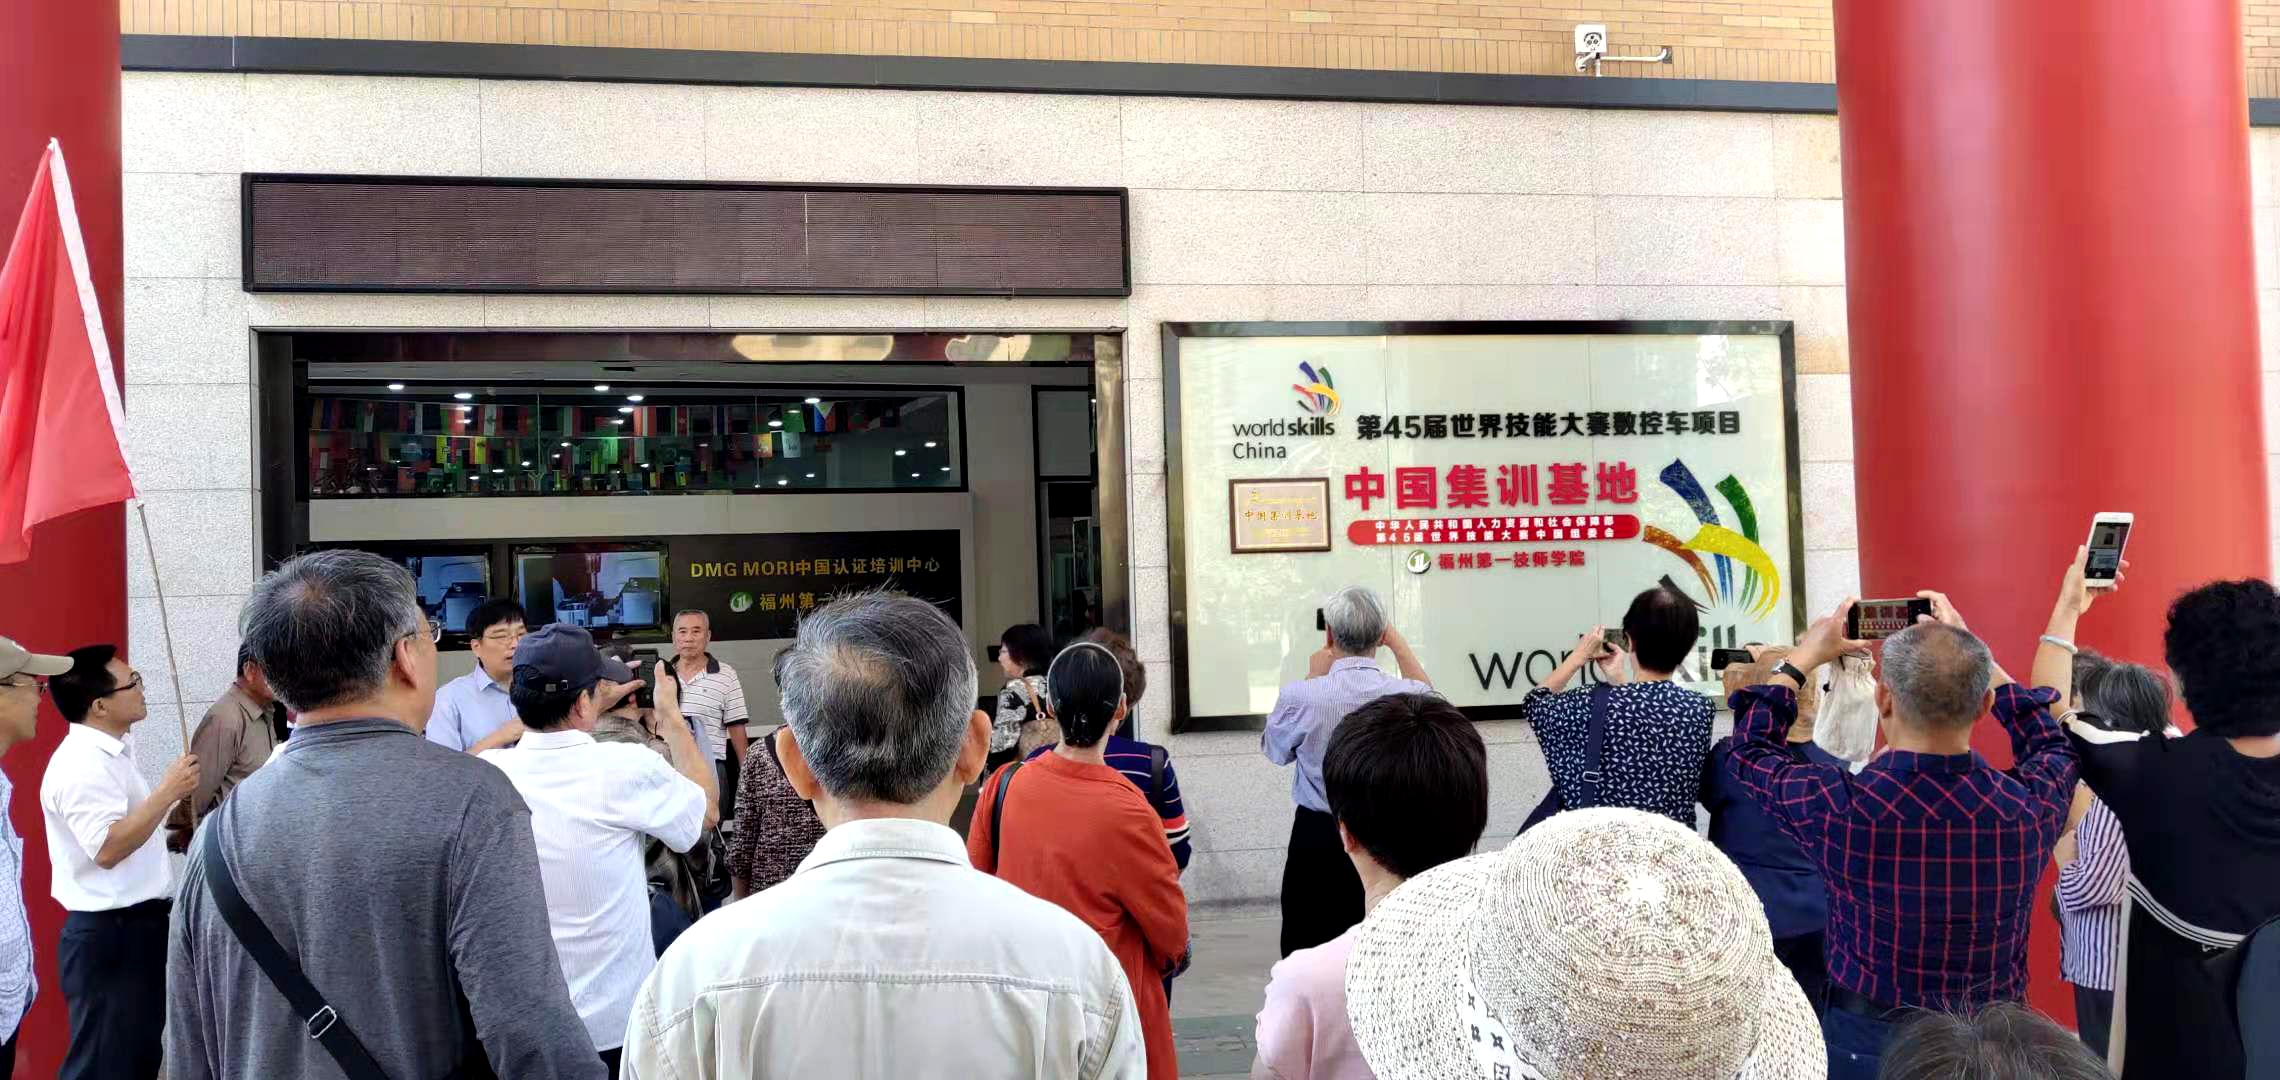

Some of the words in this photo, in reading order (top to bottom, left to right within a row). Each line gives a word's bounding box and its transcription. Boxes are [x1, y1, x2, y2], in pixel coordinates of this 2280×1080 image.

[1358, 411, 1740, 440] 第45届世界技能大赛数控车项目
[1233, 442, 1286, 459] China
[1344, 462, 1639, 511] 中国集训基地
[691, 560, 737, 577] DMG
[1438, 551, 1585, 569] 福州第一技师学院
